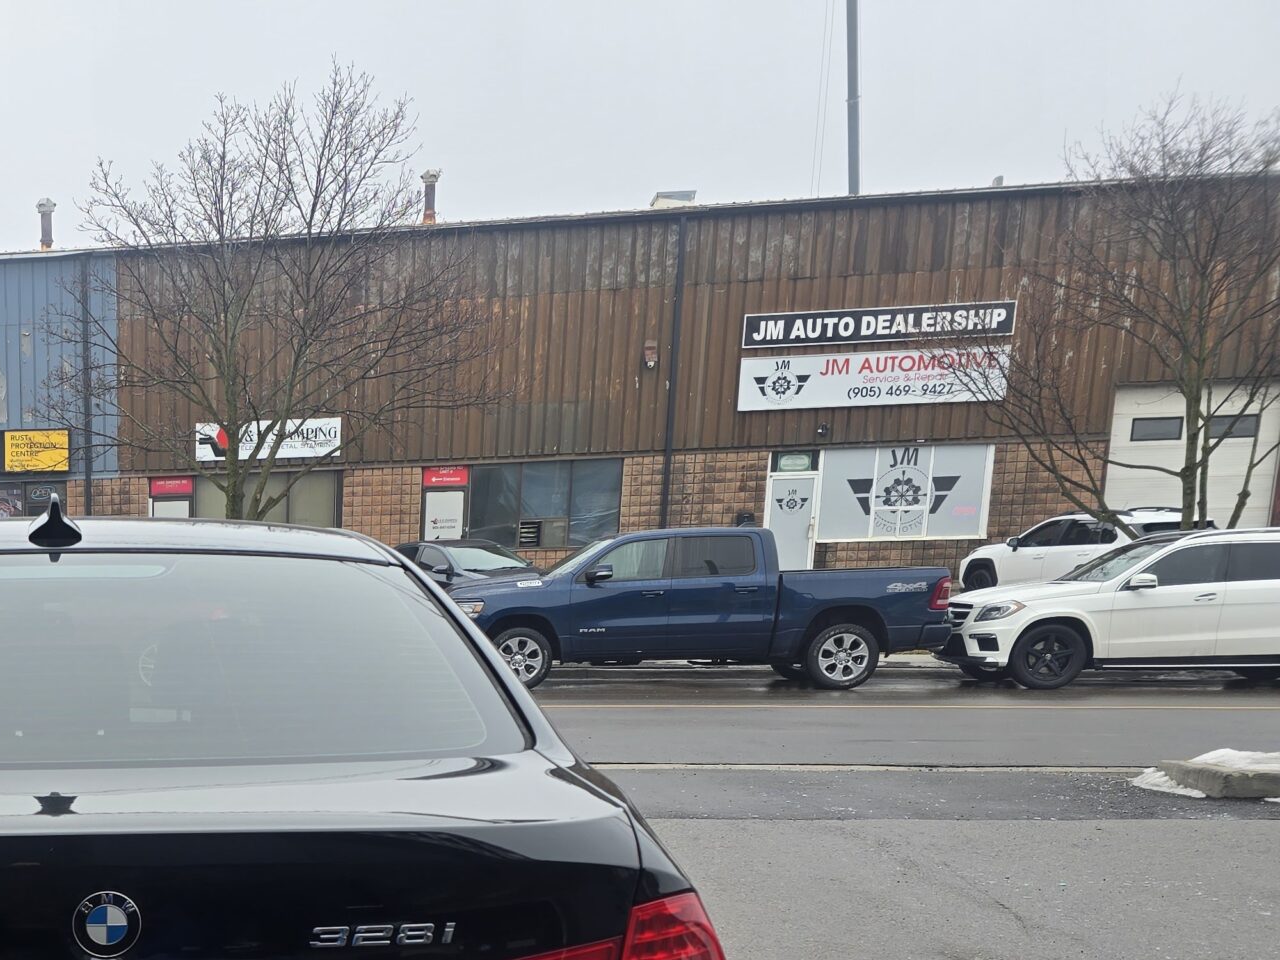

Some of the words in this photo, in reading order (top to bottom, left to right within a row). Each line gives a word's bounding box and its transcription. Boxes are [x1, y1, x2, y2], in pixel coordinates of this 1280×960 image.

[752, 320, 784, 341] JM
[789, 315, 855, 340] AUTO
[860, 308, 1007, 336] DEALERSHIP
[775, 360, 790, 371] JM
[820, 358, 850, 376] JM
[858, 351, 997, 374] AUTOMOTIVE
[862, 374, 900, 384] Service
[905, 373, 914, 382] &
[847, 386, 882, 400] (905)
[921, 382, 954, 396] 9427
[271, 426, 337, 442] SAMPING
[890, 447, 919, 468] JM
[81, 893, 135, 914] BMW
[310, 922, 456, 947] 328i
